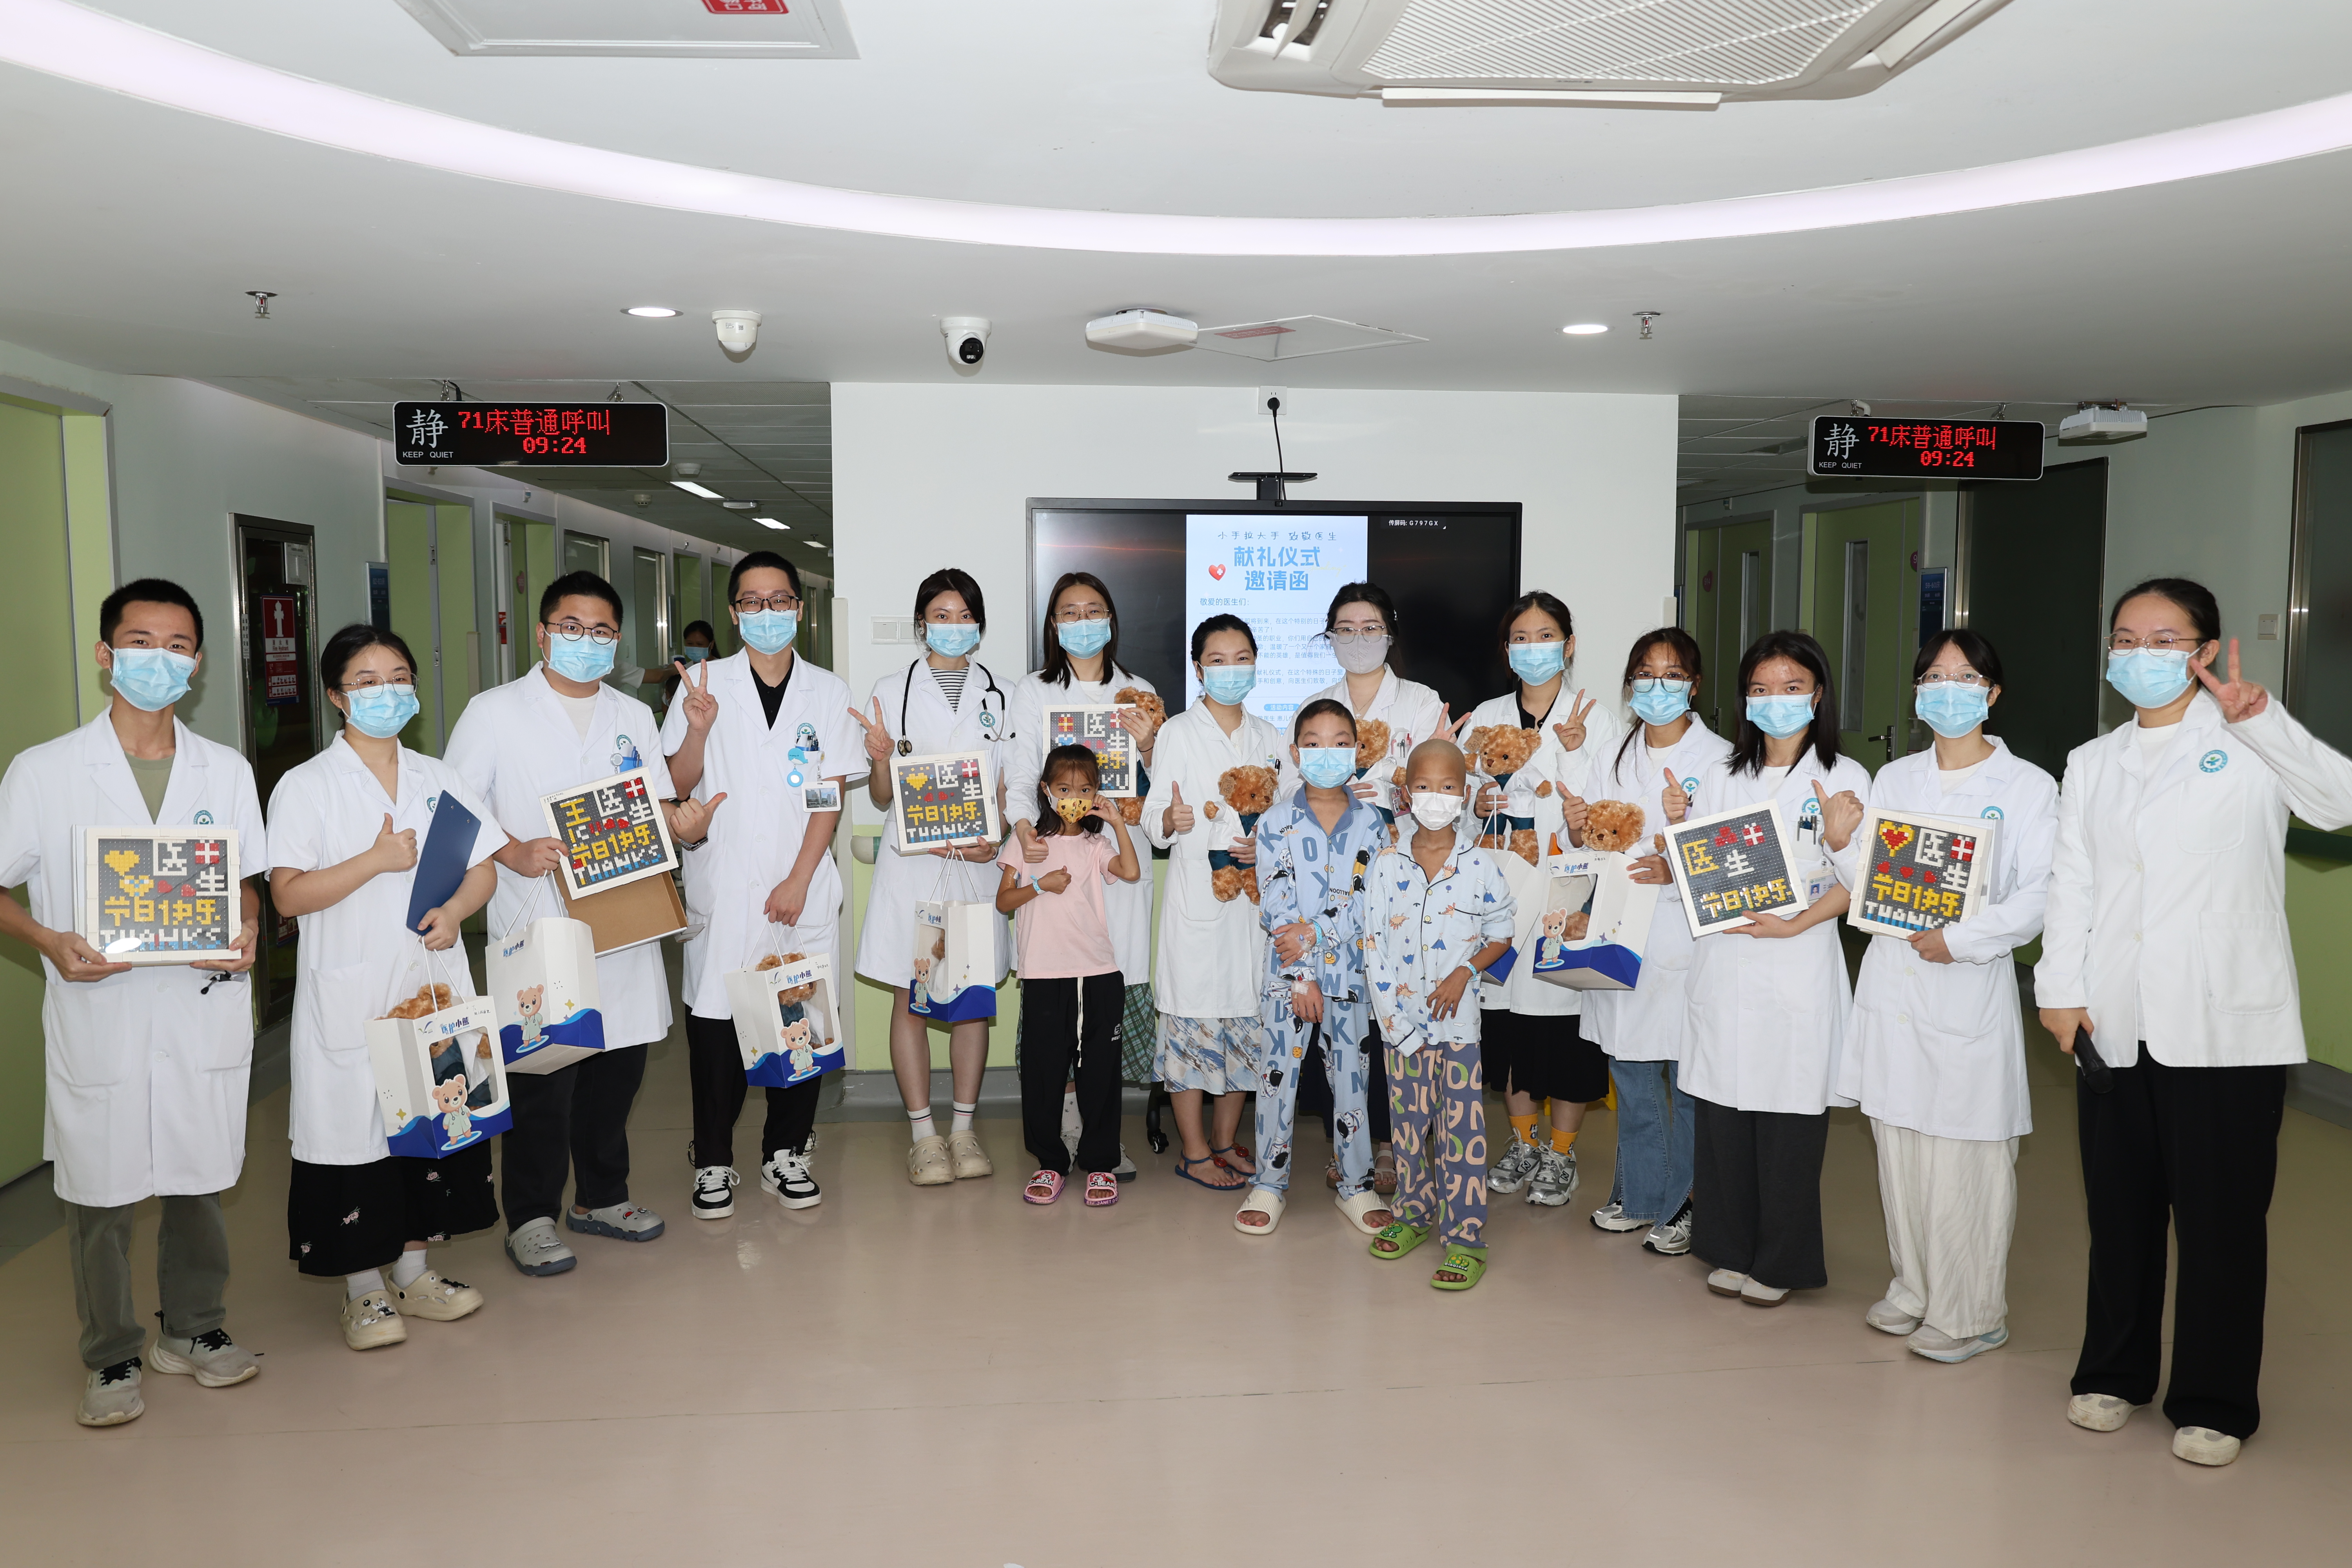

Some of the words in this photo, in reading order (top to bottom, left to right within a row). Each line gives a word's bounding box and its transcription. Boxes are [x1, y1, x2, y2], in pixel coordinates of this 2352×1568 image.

[406, 409, 448, 448] 静
[458, 409, 610, 435] 71床普通呼叫
[523, 437, 586, 453] 09:24
[1824, 423, 1859, 460] 静
[1868, 425, 1996, 450] 71床普通呼叫
[1920, 451, 1974, 467] 09:24
[1218, 531, 1279, 540] 小手拉大手
[1289, 532, 1337, 541] 致敬医生
[1234, 546, 1321, 567] 献礼仪式
[1245, 570, 1308, 591] 邀请函
